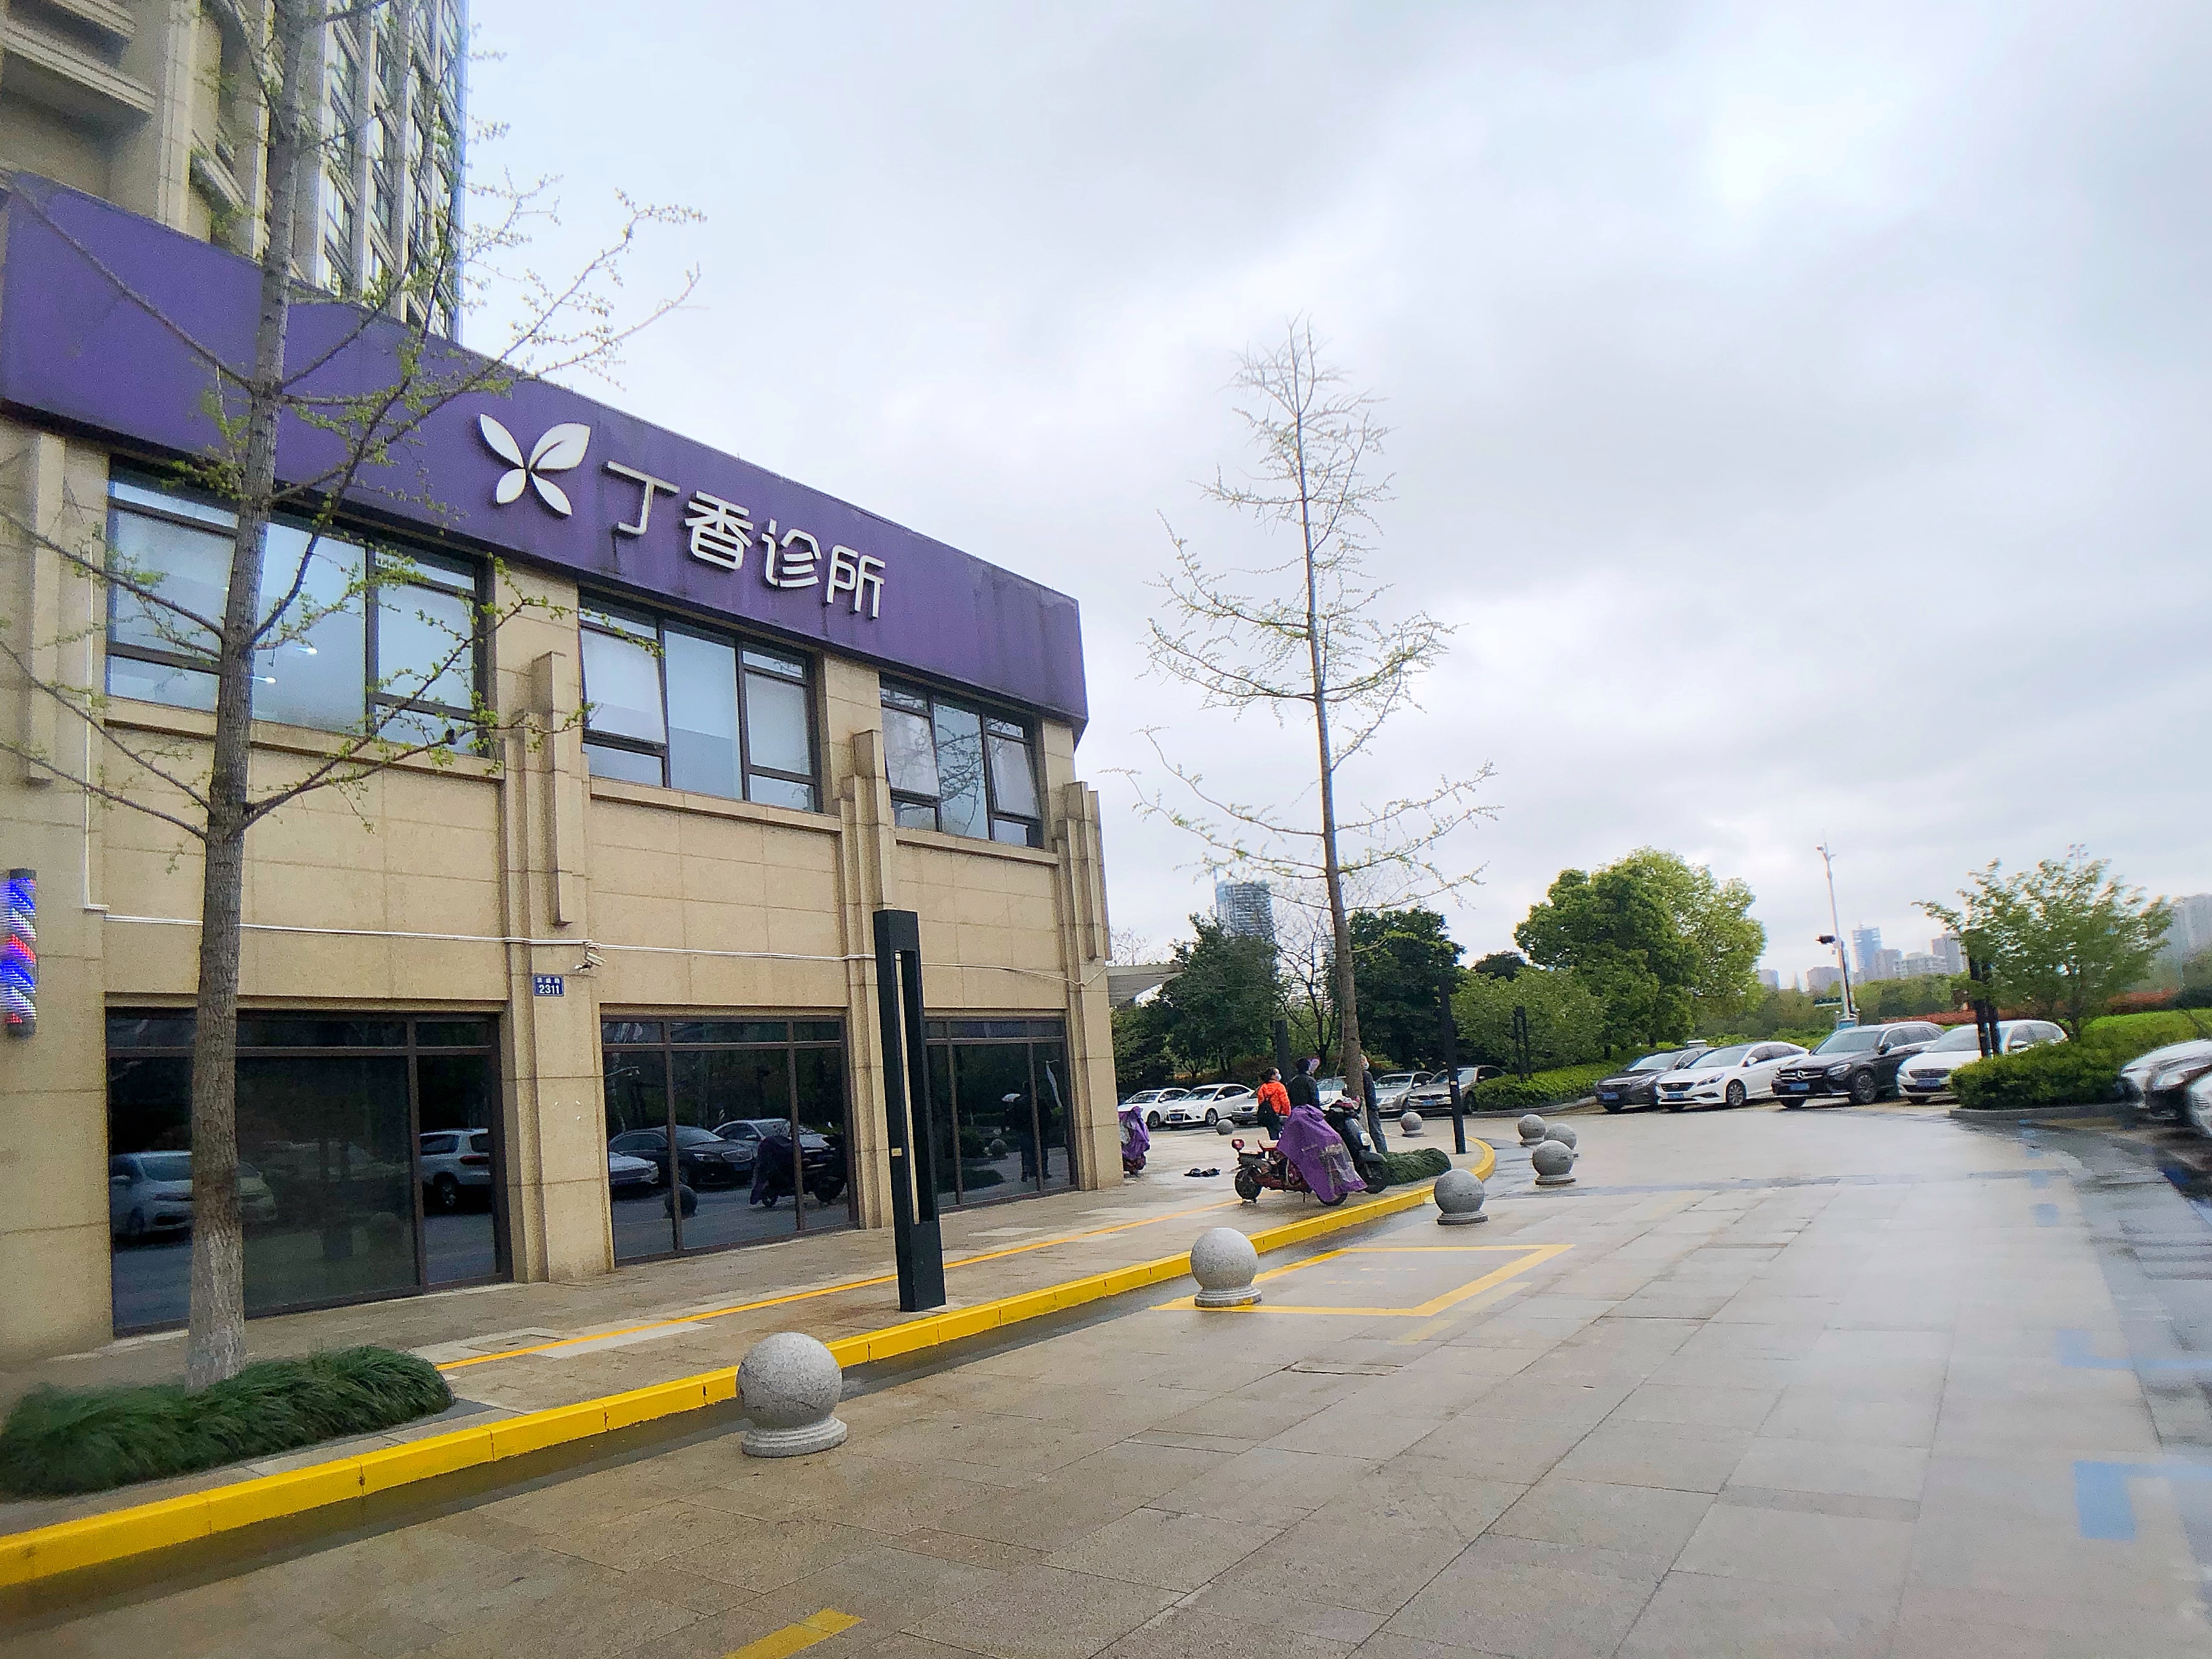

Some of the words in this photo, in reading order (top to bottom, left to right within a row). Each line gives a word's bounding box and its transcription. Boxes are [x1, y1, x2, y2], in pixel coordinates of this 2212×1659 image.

[607, 460, 886, 618] 丁香诊所
[538, 984, 560, 994] 2311
